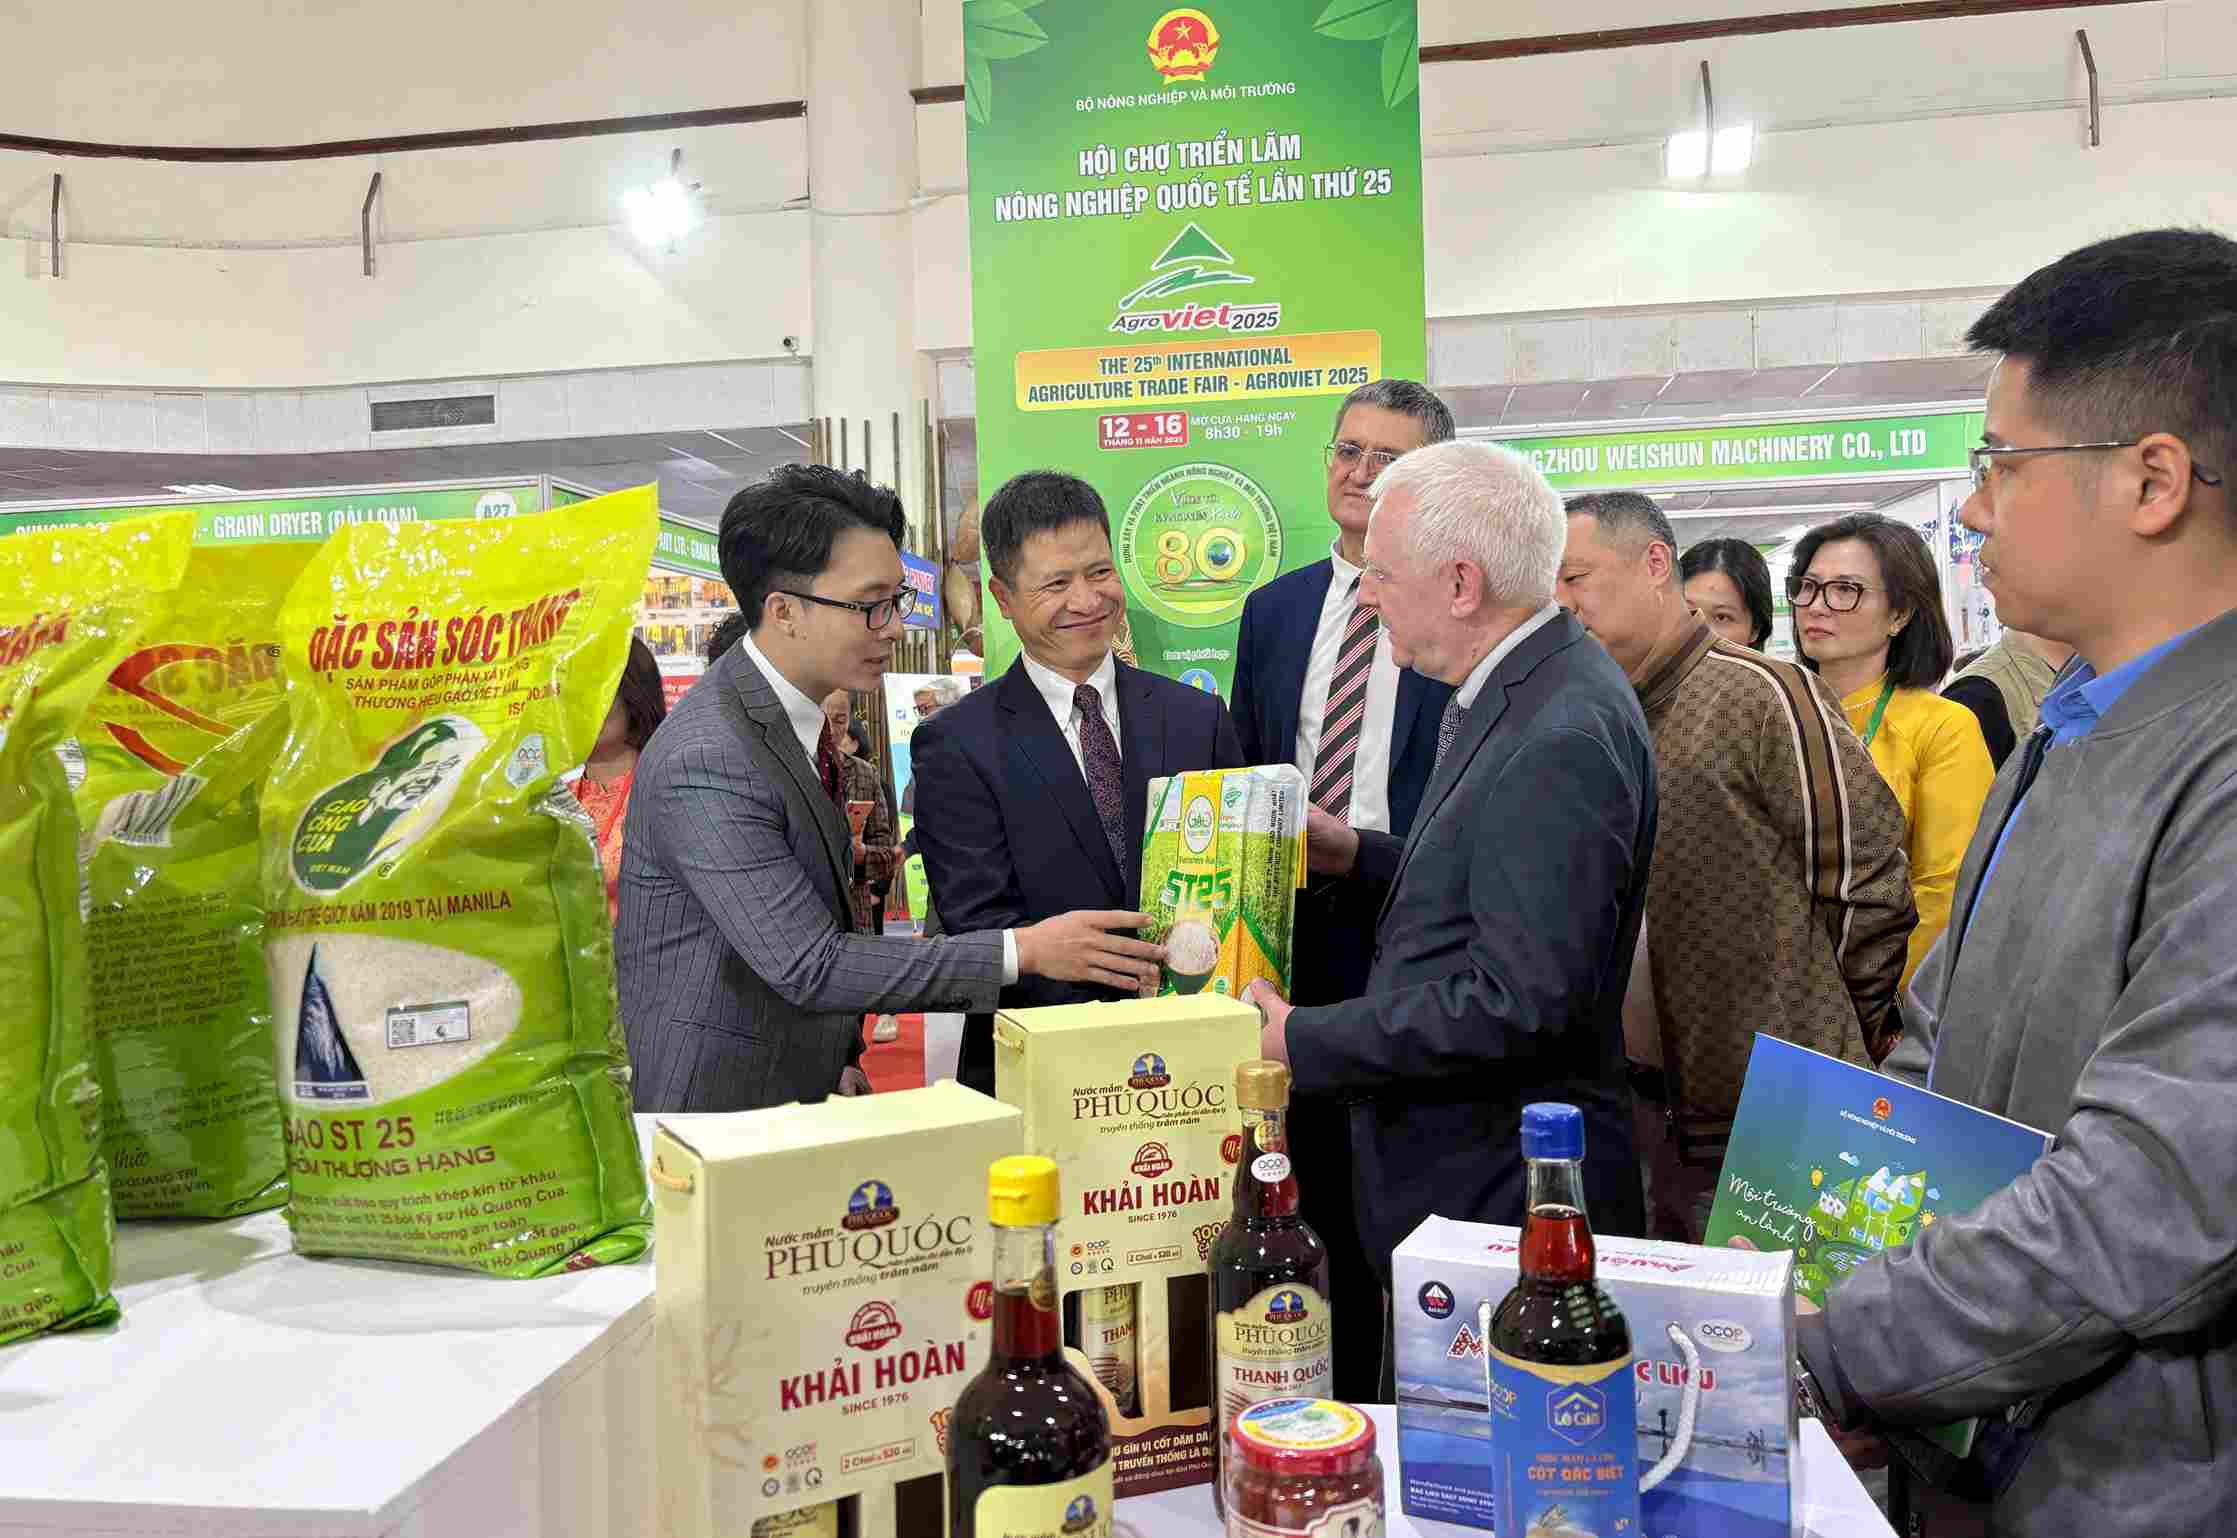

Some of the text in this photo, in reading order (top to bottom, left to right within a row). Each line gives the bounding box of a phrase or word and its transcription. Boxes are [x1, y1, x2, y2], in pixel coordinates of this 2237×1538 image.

[1079, 128, 1302, 180] HỘI CHỢ TRIỂN LÃM
[995, 165, 1391, 223] NÔNG NGHIỆP QUỐC TẾ LẦN THỨ 25
[1100, 346, 1293, 376] THE 25th INTERNATIONAL
[1028, 379, 1134, 404] AGRICULTURE
[1138, 377, 1189, 398] TRADE
[1194, 374, 1229, 395] FAIR
[1245, 369, 1323, 393] AGROVIET
[1328, 366, 1369, 387] 2025
[1102, 417, 1130, 438] 12
[1154, 414, 1182, 436] 16
[1206, 423, 1283, 441] 8h30 19h
[1606, 439, 1705, 471] WEISHUN
[1711, 433, 1834, 465] MACHINERY
[1841, 431, 1883, 461] CO.,
[1889, 427, 1927, 457] LTD
[213, 512, 266, 539] GRAIN
[269, 509, 323, 537] DRYER
[372, 606, 438, 670] SẢN
[441, 604, 503, 665] SÓC
[380, 898, 413, 921] 2019
[415, 896, 444, 924] TẠI
[446, 889, 513, 915] MANILA
[1073, 1080, 1226, 1120] PHÚ QUỐC
[330, 1115, 416, 1152] ST 25
[415, 1144, 496, 1174] HẠNG
[1083, 1173, 1221, 1217] KHẢI HOÀN
[1128, 1210, 1178, 1224] SINCE 1976
[764, 1231, 849, 1281] PHÚ
[852, 1213, 973, 1270] QUỐC
[765, 1231, 799, 1248] Nước
[880, 1267, 910, 1281] trăm
[911, 1262, 940, 1275] năm
[779, 1338, 967, 1412] KHẢI HOÀN
[1231, 1366, 1289, 1384] THANH
[841, 1392, 911, 1417] SINCE 1976
